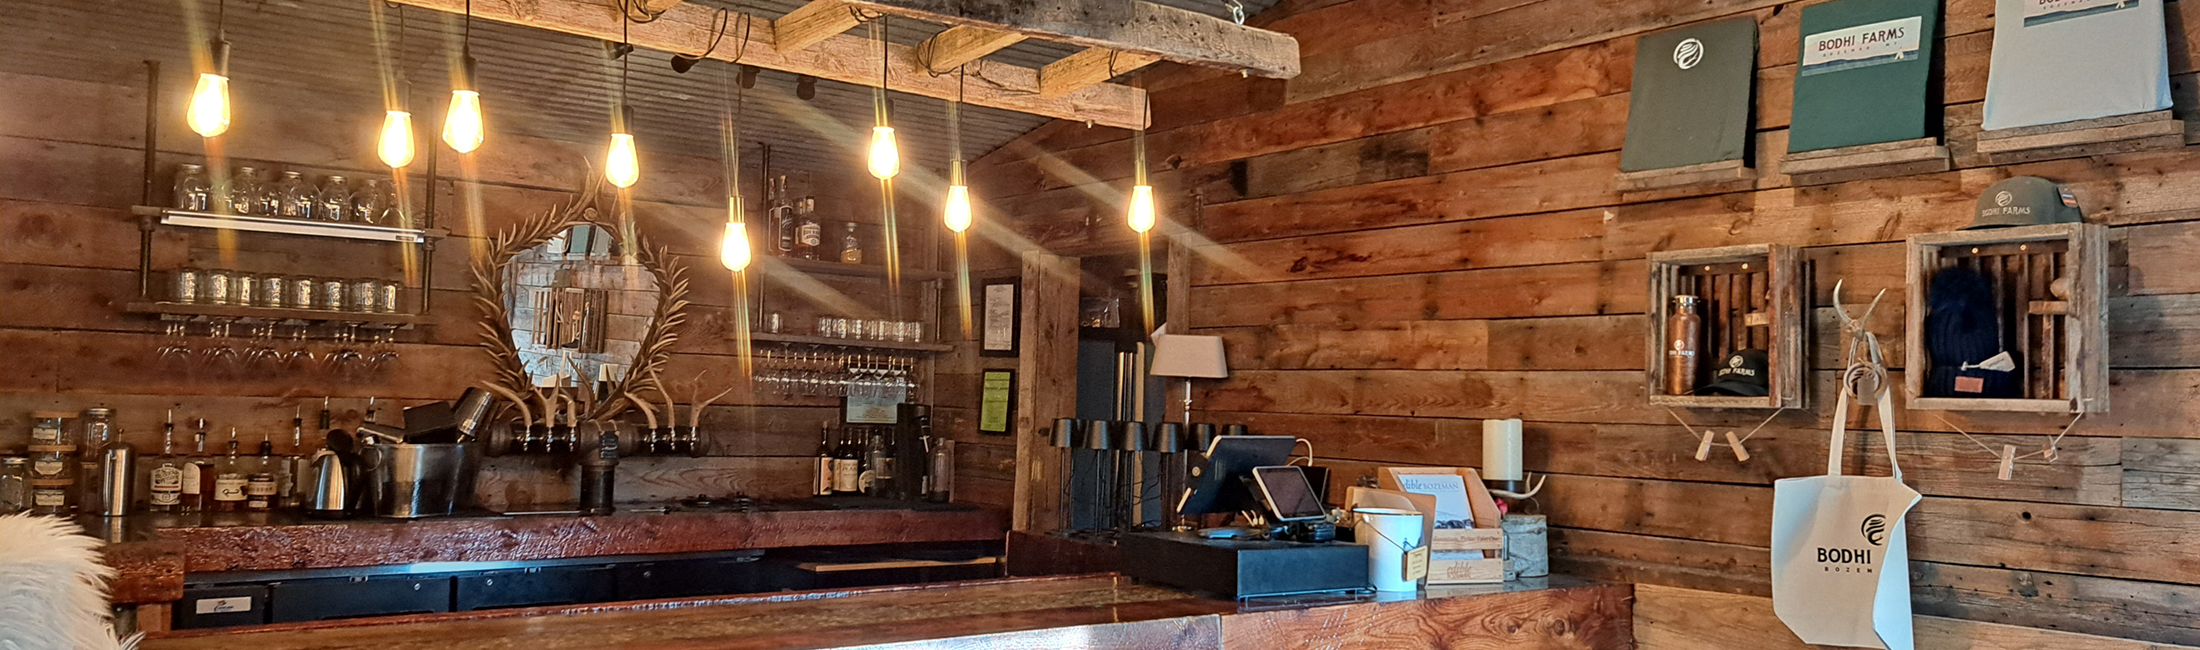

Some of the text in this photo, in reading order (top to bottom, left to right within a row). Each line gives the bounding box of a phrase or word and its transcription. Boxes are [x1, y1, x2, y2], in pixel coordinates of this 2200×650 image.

[1818, 27, 1905, 52] BODHI FARMS
[2002, 206, 2031, 215] FARMS
[1423, 481, 1459, 489] BOZEMAN
[1817, 547, 1871, 564] BODHI
